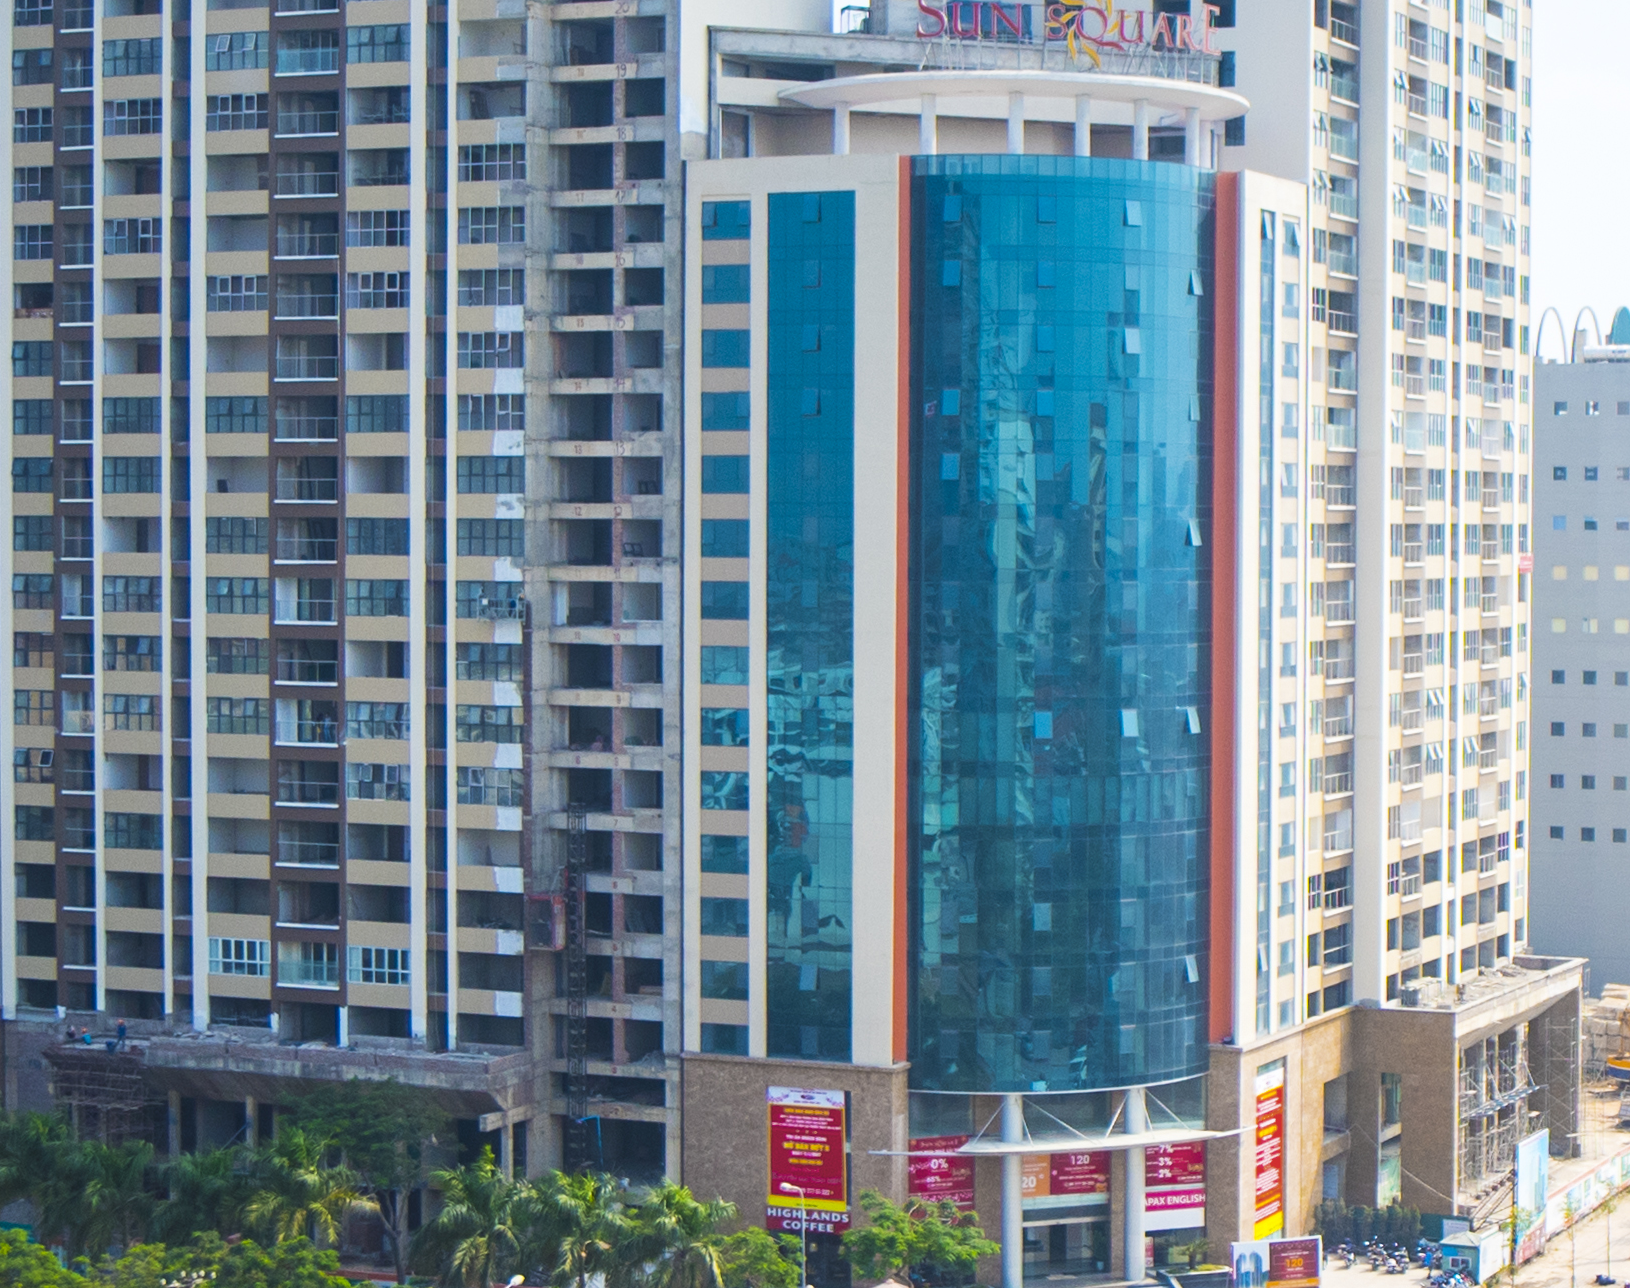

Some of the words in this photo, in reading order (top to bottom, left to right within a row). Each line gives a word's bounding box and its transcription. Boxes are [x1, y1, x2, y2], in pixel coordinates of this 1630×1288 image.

[615, 2, 630, 14] 20
[615, 64, 627, 77] 19
[617, 127, 626, 139] 18
[615, 441, 625, 455] 13
[1070, 1154, 1090, 1165] 120
[1167, 1194, 1206, 1206] ENGLISH
[767, 1207, 849, 1223] HIGHLANDS
[782, 1220, 835, 1233] COFFEE
[1285, 1257, 1303, 1268] 120
